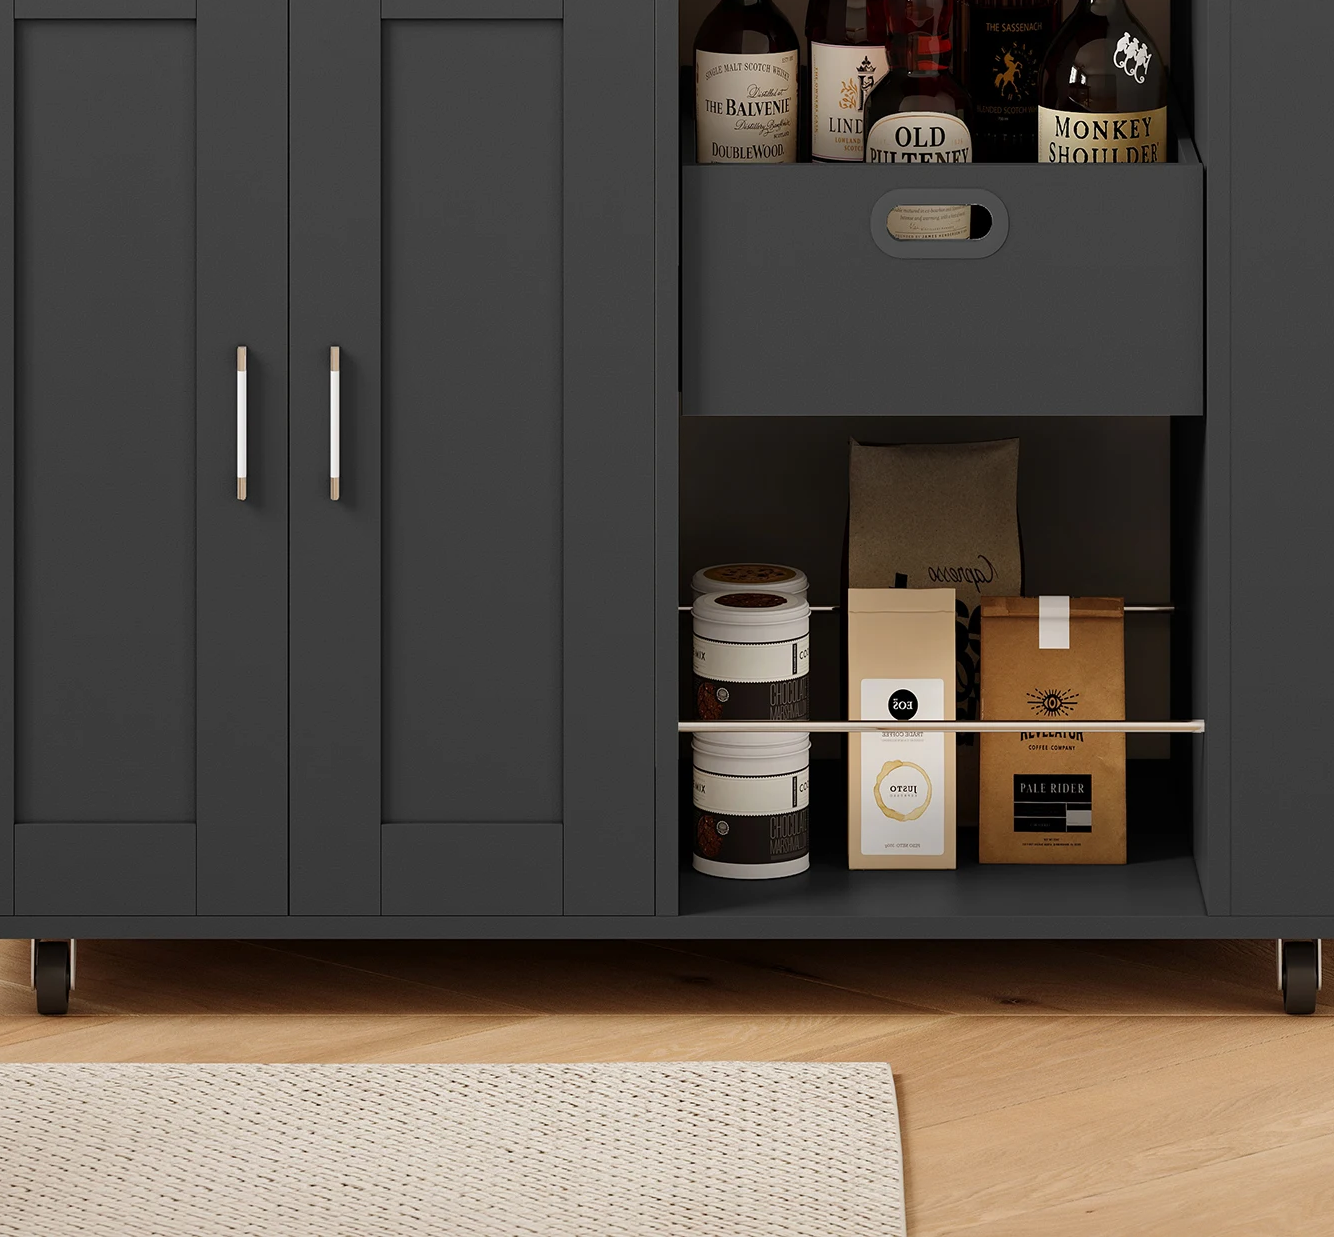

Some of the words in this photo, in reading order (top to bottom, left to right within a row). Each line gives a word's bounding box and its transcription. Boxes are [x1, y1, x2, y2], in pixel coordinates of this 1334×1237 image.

[986, 22, 1000, 32] THE
[1001, 22, 1043, 33] SASSENACH
[705, 65, 723, 81] SINGLE
[723, 62, 743, 73] MALT
[744, 62, 771, 73] SCOTCH
[705, 98, 723, 115] THE
[725, 97, 790, 117] BALVENIE
[895, 126, 946, 148] OLD
[1055, 115, 1152, 140] MONKEY
[1020, 782, 1047, 794] PALE
[1050, 782, 1085, 794] RIDER
